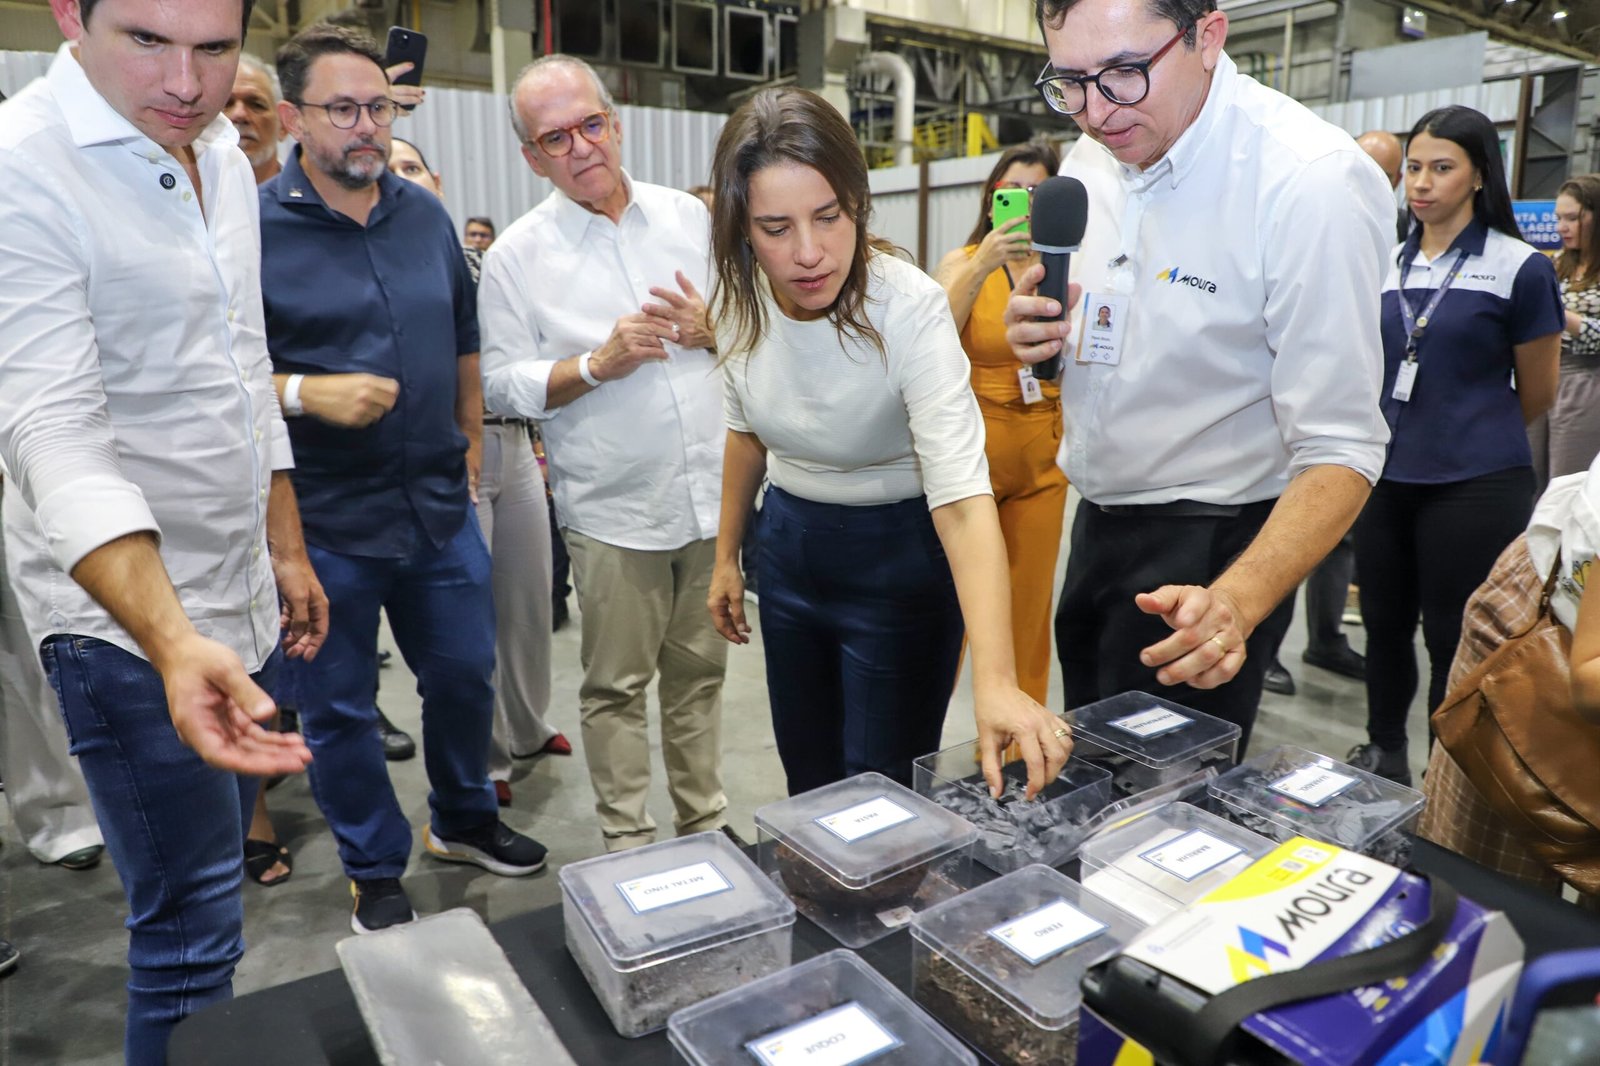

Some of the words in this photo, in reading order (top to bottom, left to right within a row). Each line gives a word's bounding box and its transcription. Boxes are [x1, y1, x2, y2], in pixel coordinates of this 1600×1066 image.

[854, 812, 879, 823] PASTA
[671, 875, 704, 887] METAL
[643, 884, 669, 895] FINO
[1275, 866, 1374, 942] Moura
[1034, 921, 1064, 937] FERRO
[803, 1032, 846, 1054] COQUE
